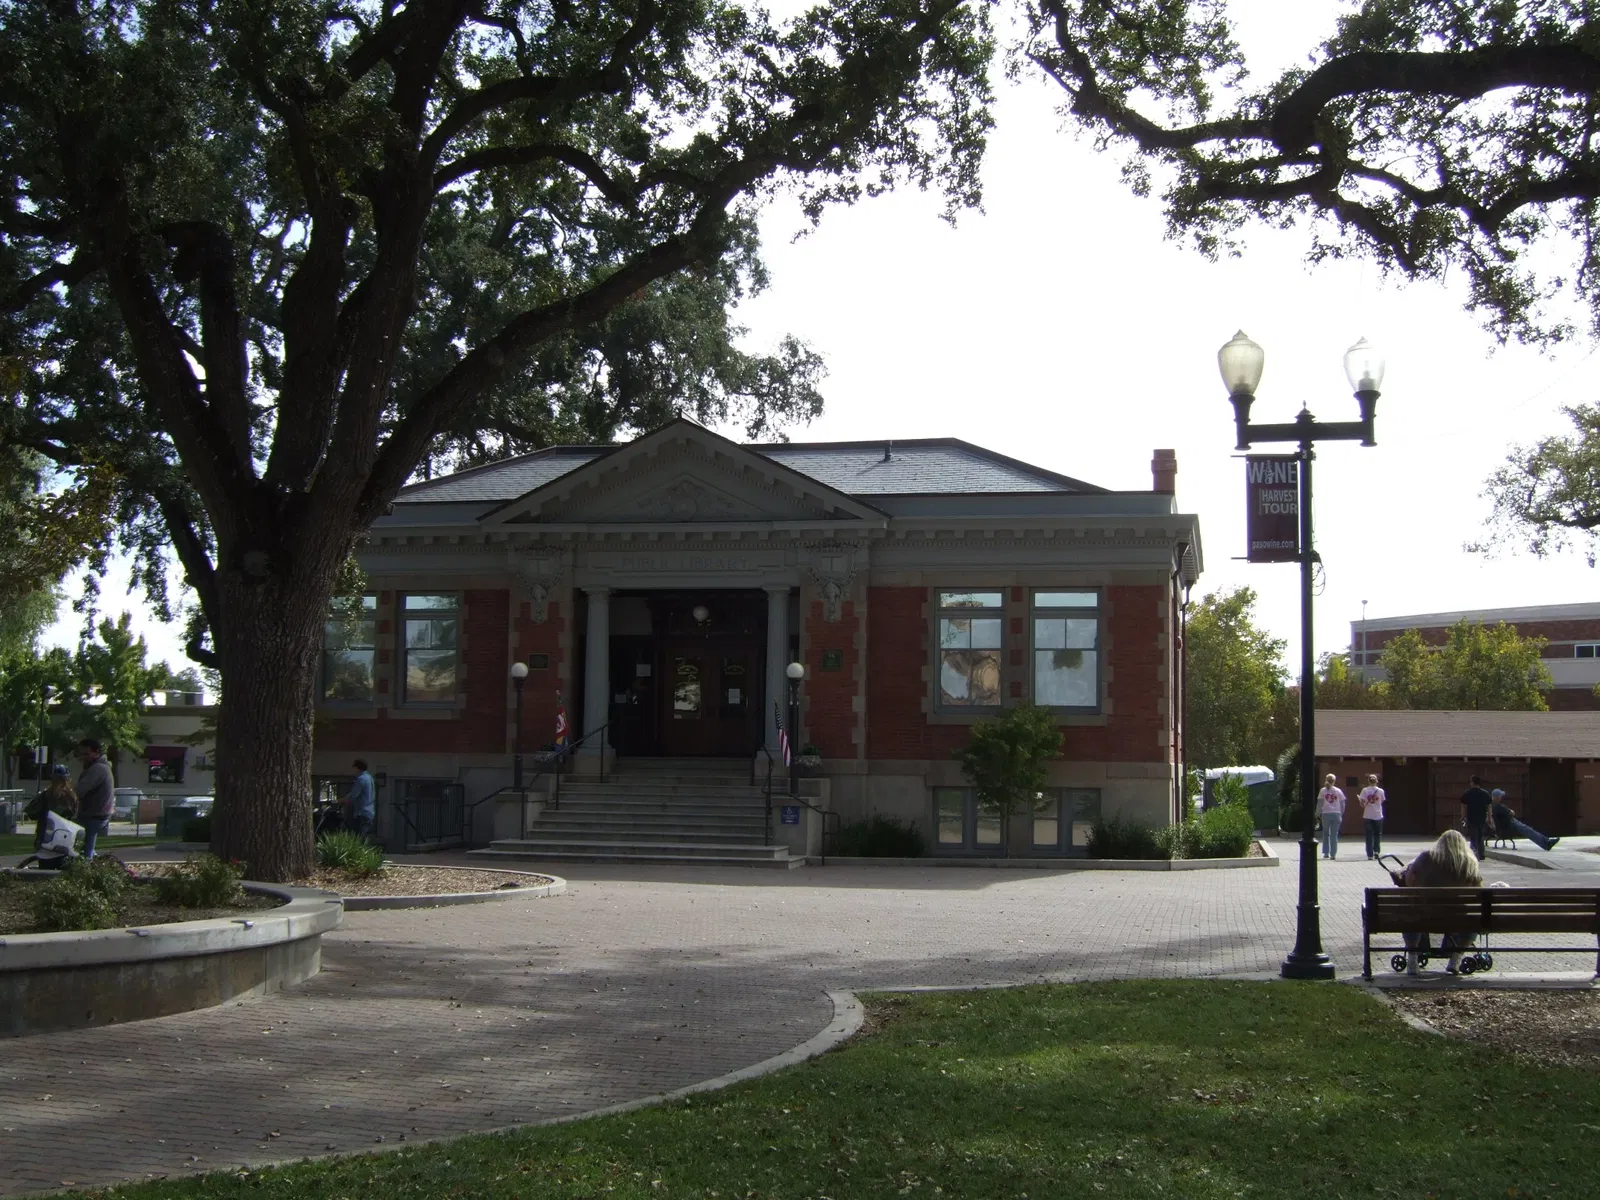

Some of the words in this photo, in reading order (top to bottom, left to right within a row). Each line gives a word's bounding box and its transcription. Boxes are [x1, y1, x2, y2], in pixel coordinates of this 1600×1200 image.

[1248, 460, 1297, 485] WINE
[1262, 489, 1298, 502] HARVEST
[1262, 502, 1298, 515] TOUR
[1252, 538, 1295, 551] pasowine.com
[621, 555, 669, 570] PUBLIC
[680, 555, 749, 570] LIBRARY
